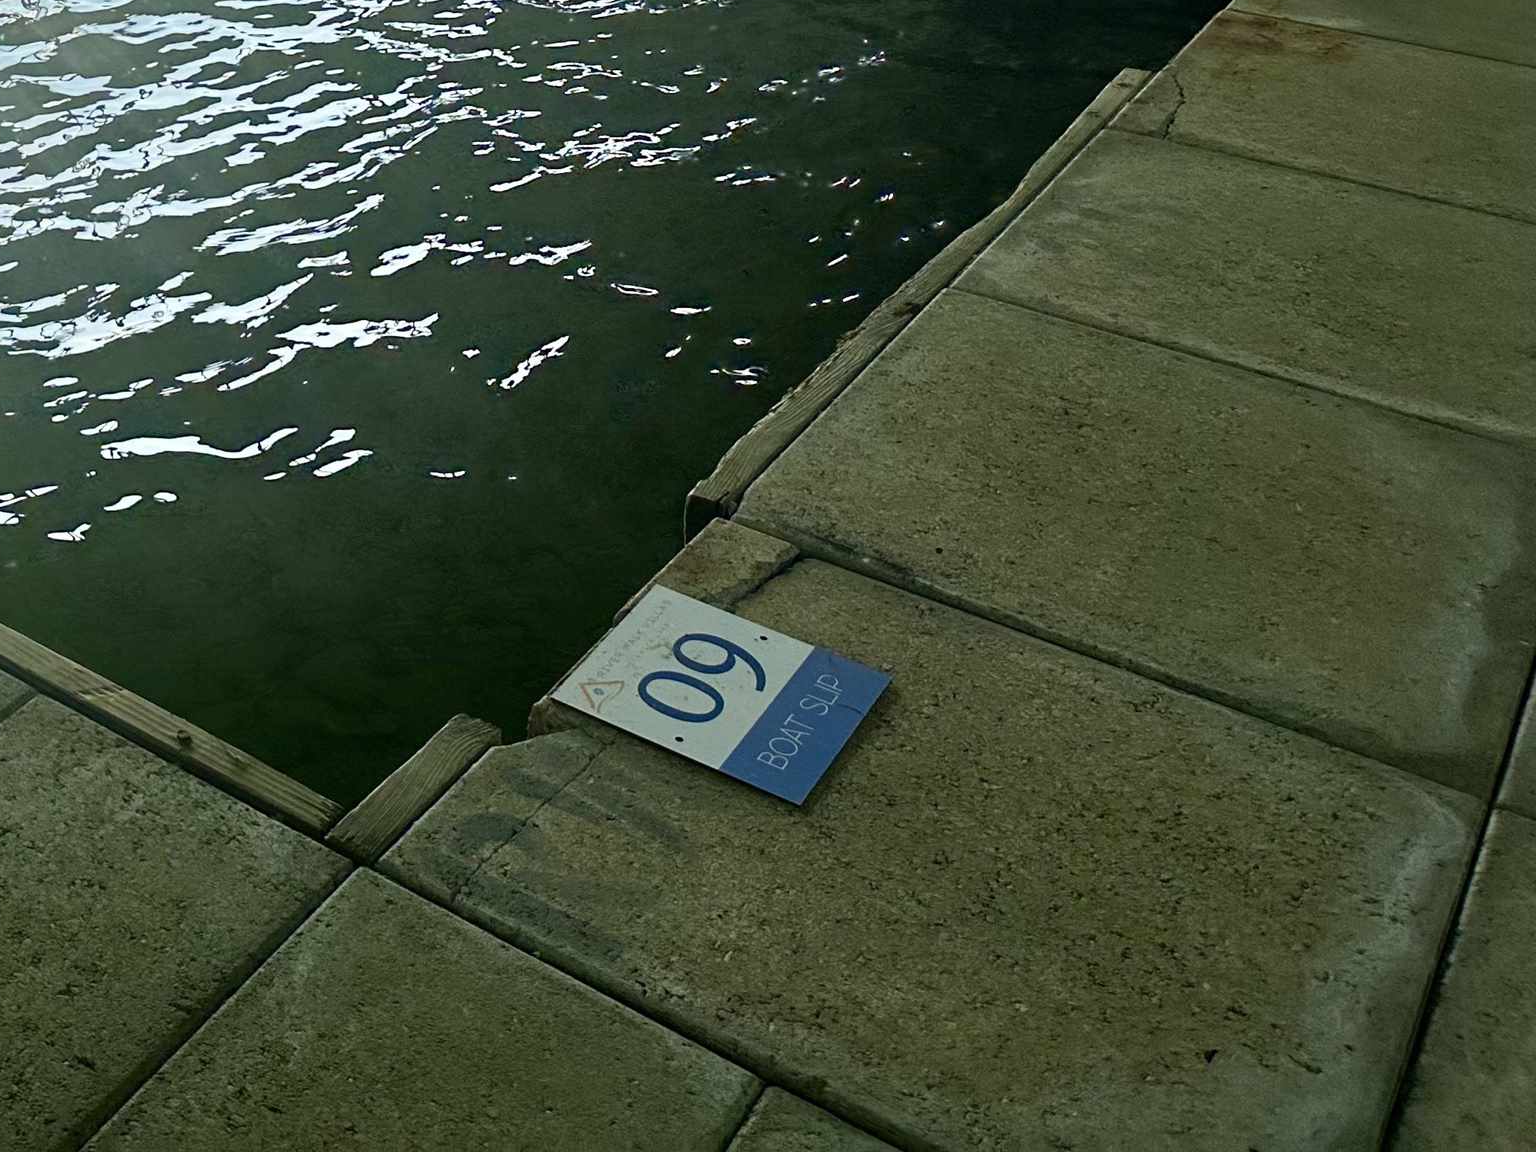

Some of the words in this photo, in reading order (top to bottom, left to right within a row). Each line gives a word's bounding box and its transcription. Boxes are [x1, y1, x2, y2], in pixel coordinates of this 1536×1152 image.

[637, 633, 767, 724] 09
[757, 714, 815, 770] BOAT
[799, 673, 844, 717] SLIP
